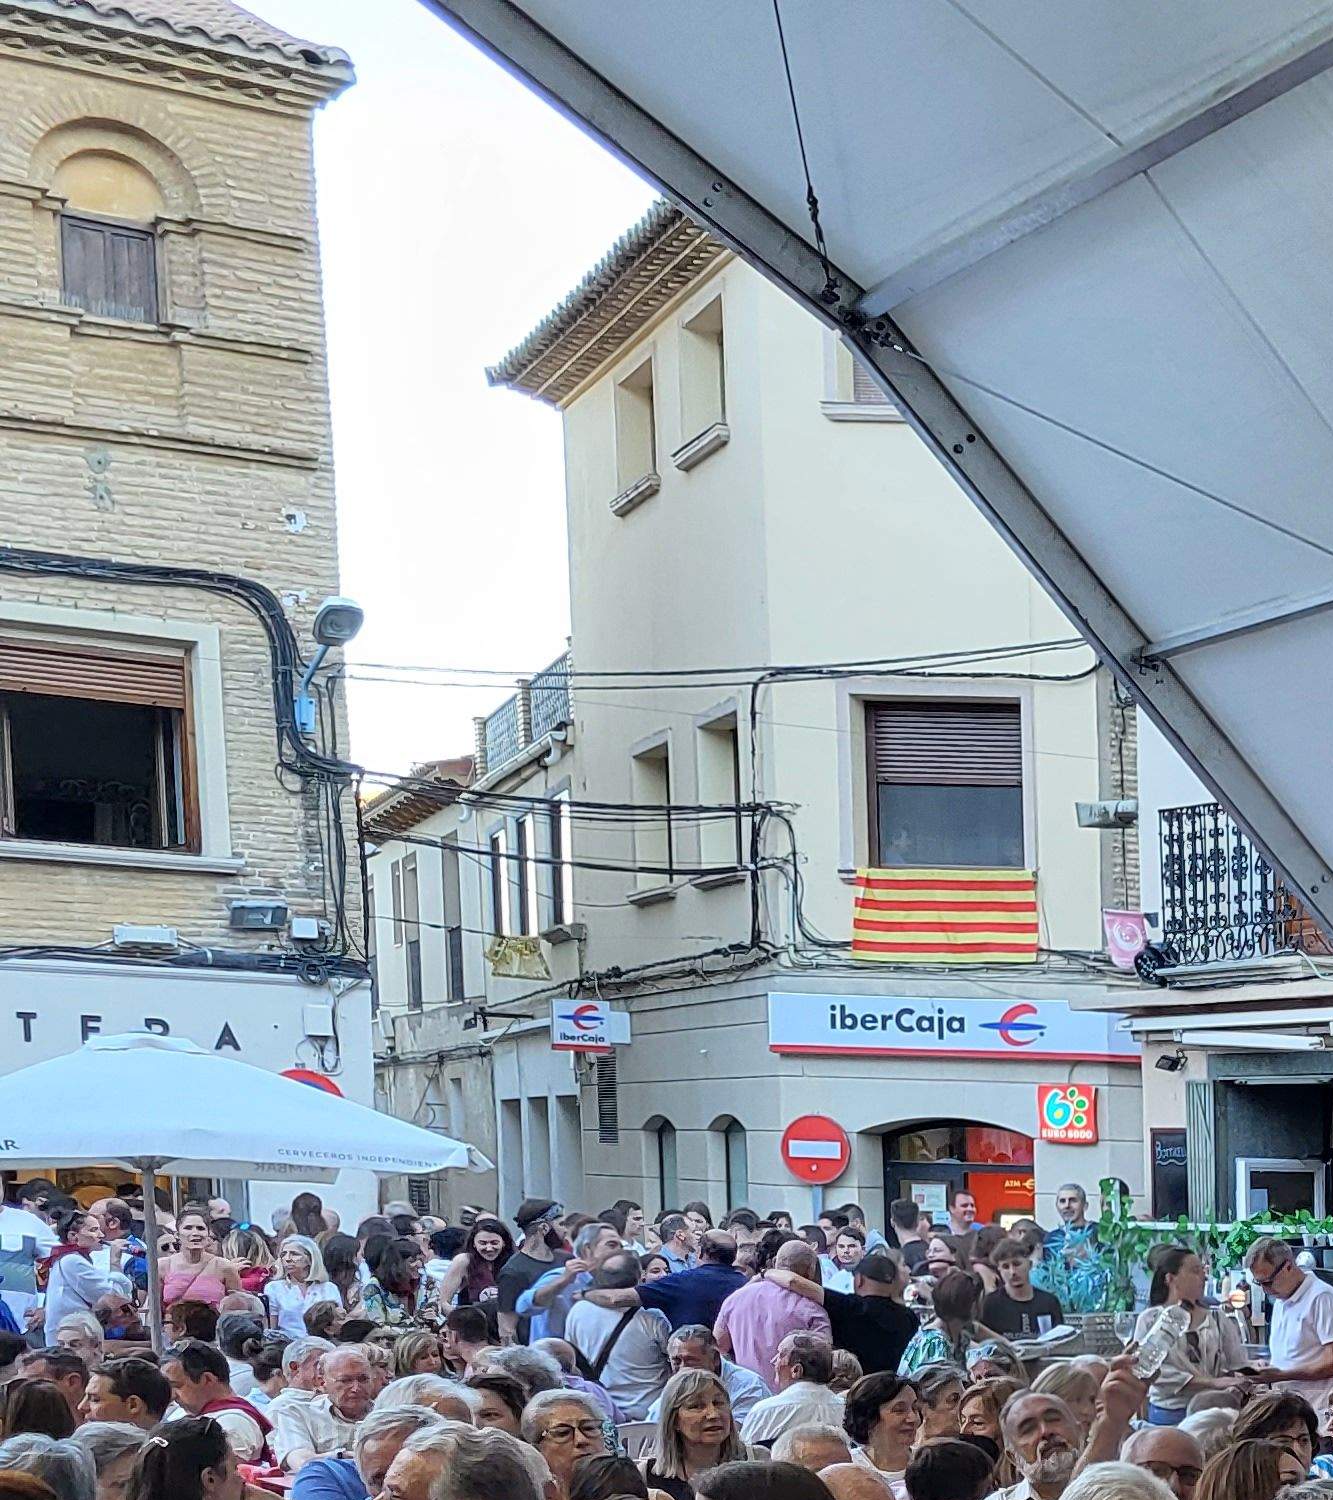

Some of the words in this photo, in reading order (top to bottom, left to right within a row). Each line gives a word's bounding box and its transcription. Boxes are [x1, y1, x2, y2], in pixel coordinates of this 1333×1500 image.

[829, 1004, 966, 1041] iberCaja
[559, 1032, 606, 1044] iberCaja
[278, 1148, 353, 1161] CERVECEROS
[357, 1154, 444, 1168] INDEPENDIEN
